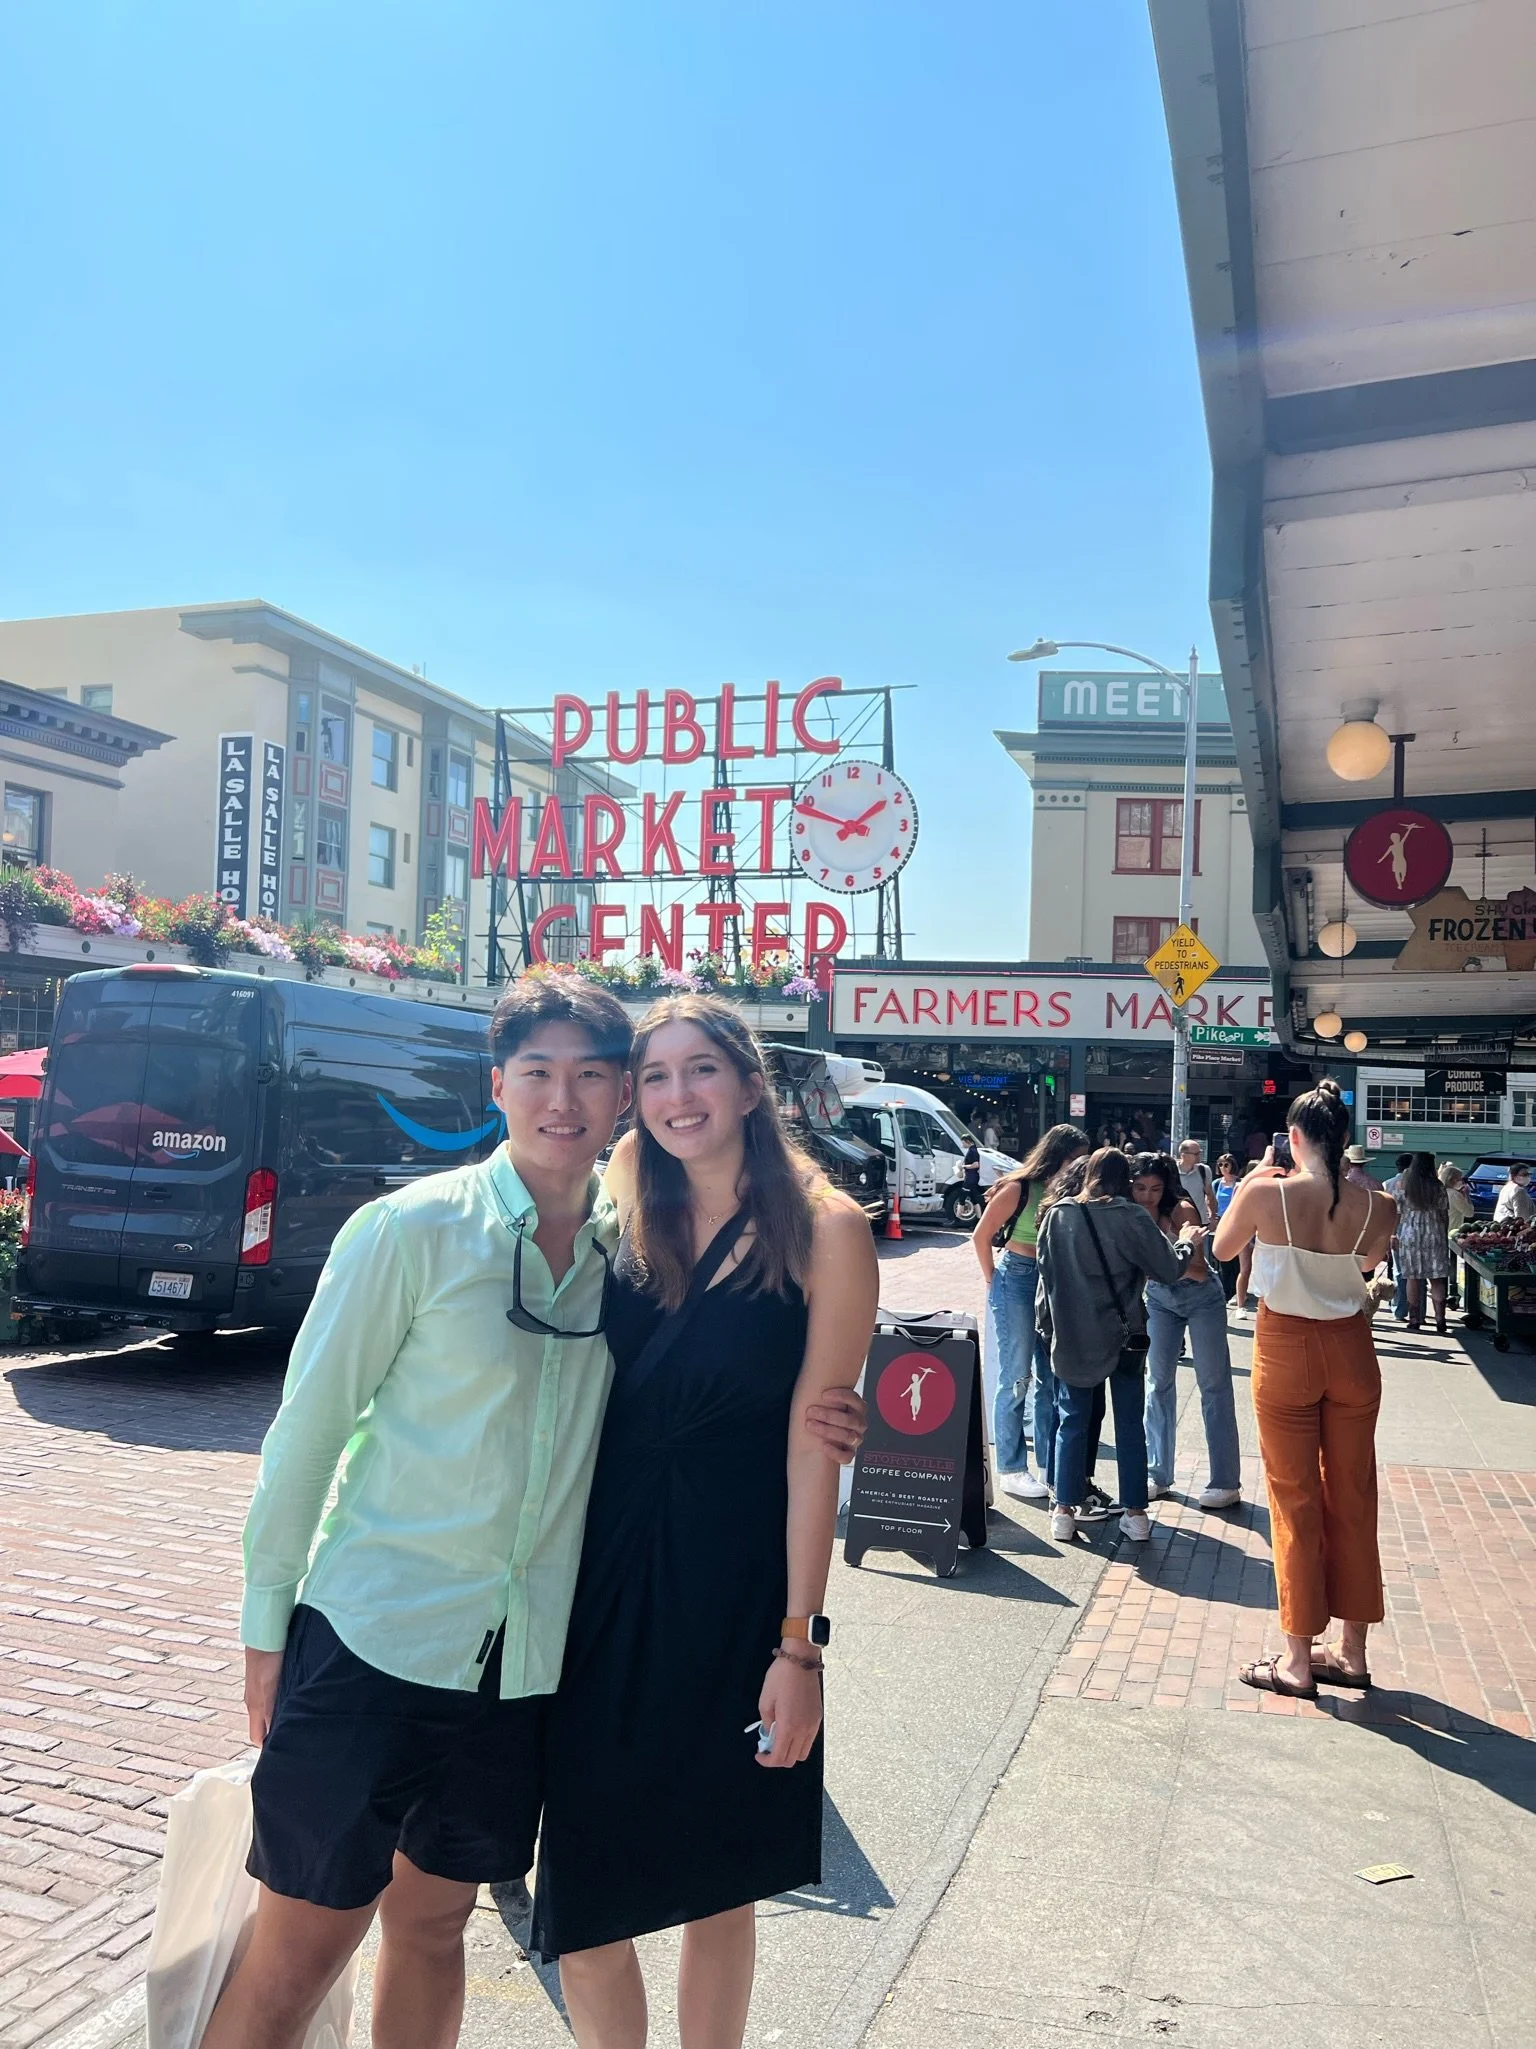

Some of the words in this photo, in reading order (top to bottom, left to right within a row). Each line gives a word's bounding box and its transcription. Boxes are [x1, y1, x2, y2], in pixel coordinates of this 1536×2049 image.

[1063, 680, 1185, 716] MEET
[550, 676, 842, 768] PUBLIC
[224, 741, 246, 772] LA
[266, 747, 281, 780] LA
[847, 766, 860, 779] 12
[876, 773, 882, 785] 1
[822, 774, 832, 788] 11
[803, 795, 815, 808] 10
[894, 792, 902, 804] 2
[223, 778, 246, 860] SALLE
[899, 819, 908, 832] 3
[263, 787, 279, 867] SALLE
[470, 786, 794, 880] MARKET
[795, 822, 805, 835] 9
[801, 849, 811, 862] 8
[890, 846, 901, 859] 4
[820, 868, 830, 880] 7
[872, 867, 882, 879] 5
[844, 875, 854, 887] 6
[1428, 918, 1526, 941] FROZEN
[1171, 938, 1195, 948] YIELD
[1177, 949, 1188, 959] TO
[1154, 961, 1209, 970] PEDESTRIANS
[853, 987, 1072, 1028] FARMERS
[1196, 1026, 1227, 1042] Pike
[1444, 1080, 1485, 1093] PRODUCE
[152, 1130, 227, 1152] amazon
[151, 1280, 189, 1296] C51467V
[863, 1452, 955, 1470] STORYVILLE
[861, 1466, 901, 1477] COFFEE
[904, 1471, 953, 1482] COMPANY
[897, 1526, 923, 1534] FLOOR
